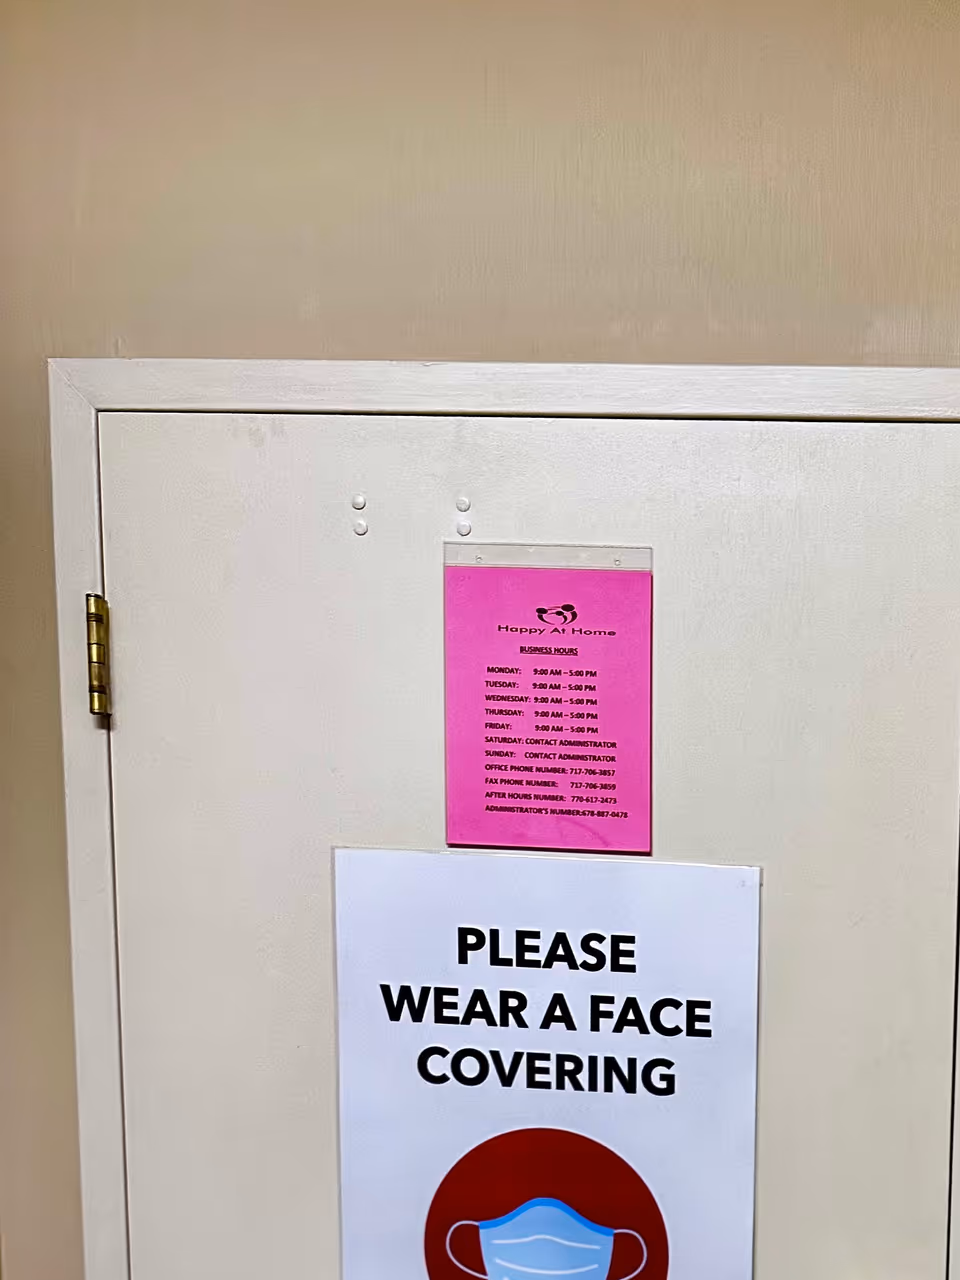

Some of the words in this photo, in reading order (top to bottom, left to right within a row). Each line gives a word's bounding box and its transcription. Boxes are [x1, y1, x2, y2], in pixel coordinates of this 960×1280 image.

[498, 625, 545, 635] Happy
[551, 626, 565, 634] At
[572, 628, 616, 636] Home
[520, 646, 552, 654] BUSINESS
[554, 647, 578, 655] HOURS
[485, 695, 531, 703] WEDNESDAY:
[485, 708, 524, 716] THURSDAY:
[485, 736, 524, 744] SATURDAY:
[526, 738, 557, 746] CONTACT
[559, 740, 617, 748] ADMINISTRATOR
[485, 750, 516, 758] SUNDAY:
[525, 752, 556, 760] CONTACT
[558, 753, 616, 762] ADMINISTRATOR
[510, 765, 534, 773] PHONE
[526, 780, 558, 788] NUMBER:
[534, 794, 566, 802] NUMBER:
[457, 927, 636, 973] PLEASE
[380, 984, 528, 1028] WEAR
[540, 993, 577, 1031] A
[590, 994, 712, 1037] FACE
[417, 1046, 675, 1097] COVERING
